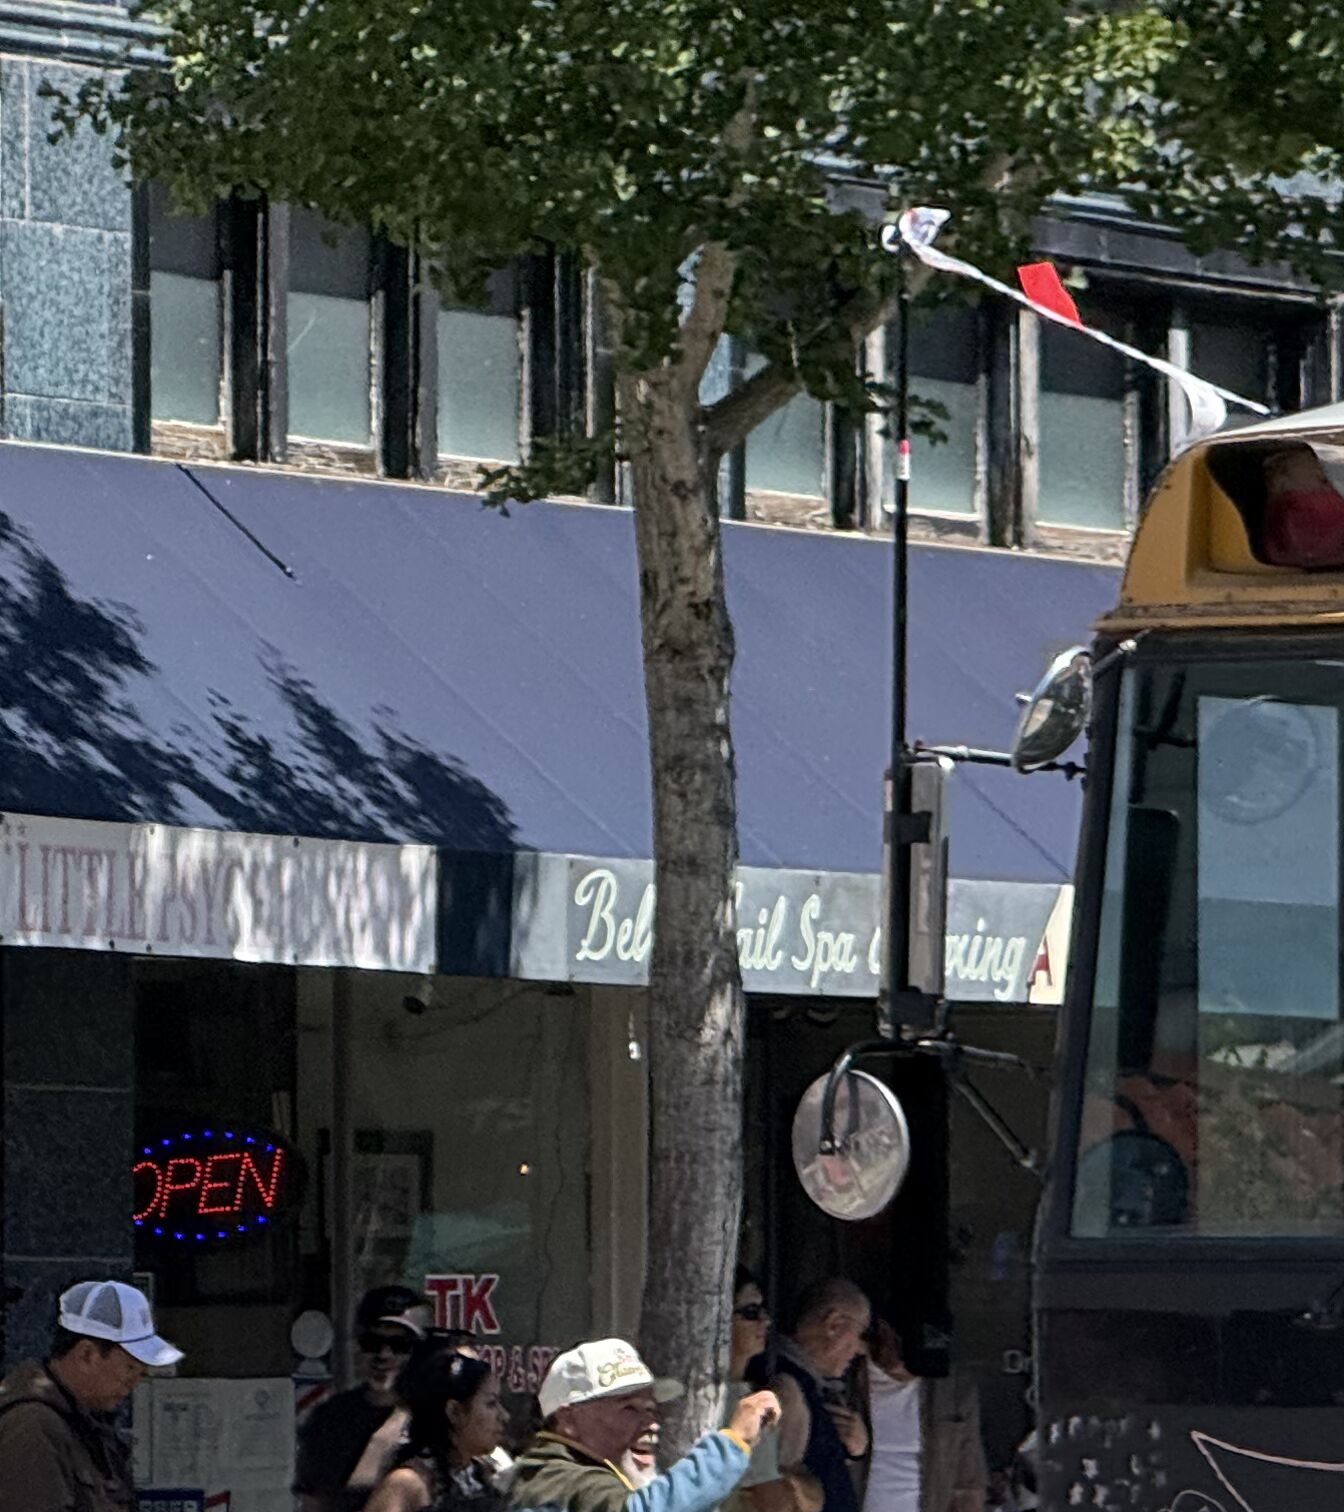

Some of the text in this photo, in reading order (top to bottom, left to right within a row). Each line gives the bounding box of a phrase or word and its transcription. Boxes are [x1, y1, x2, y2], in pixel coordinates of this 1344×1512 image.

[736, 882, 786, 971] ail
[793, 893, 857, 989] Spa
[425, 1274, 500, 1335] TK
